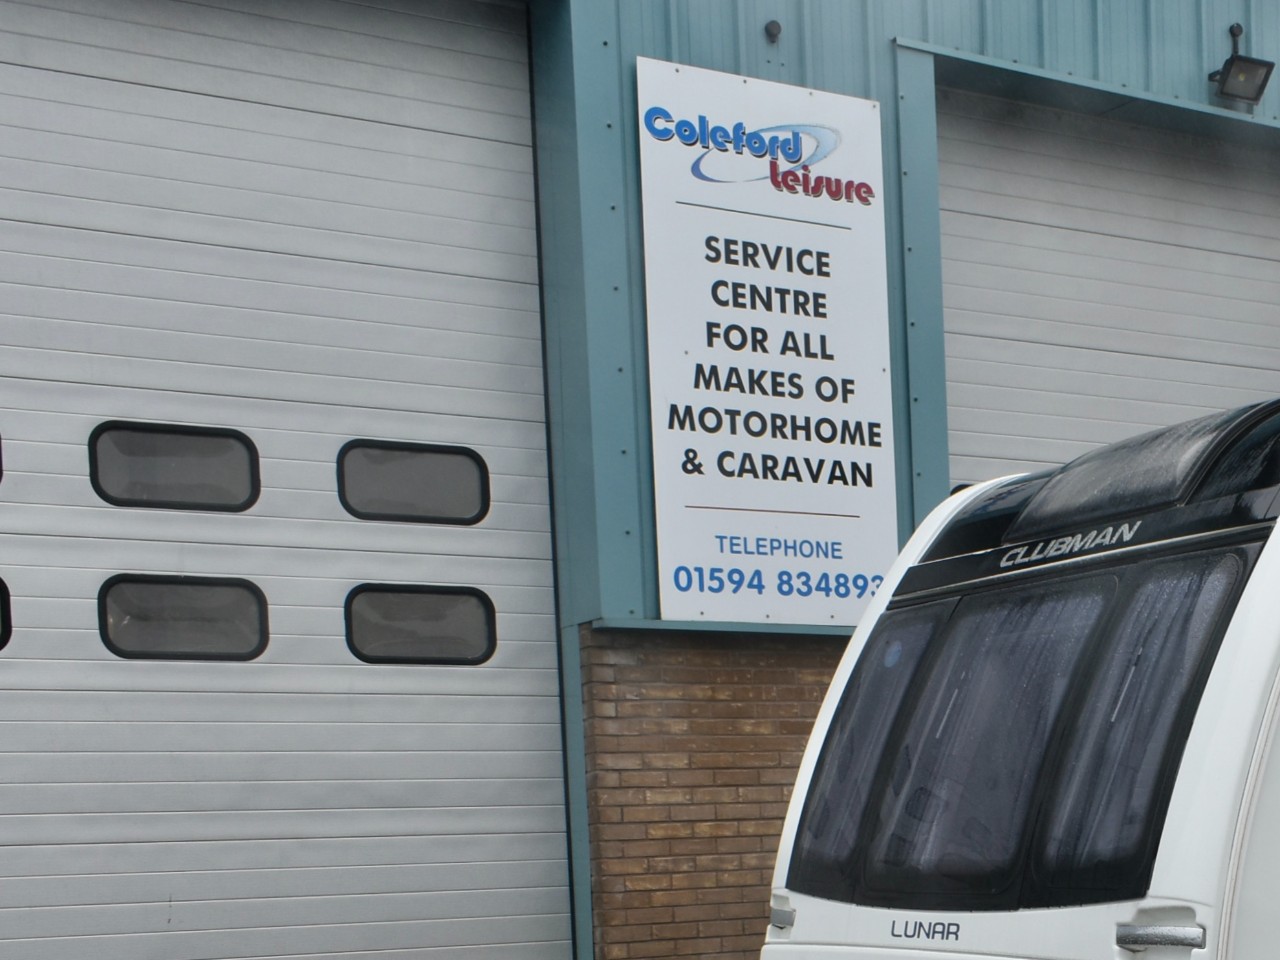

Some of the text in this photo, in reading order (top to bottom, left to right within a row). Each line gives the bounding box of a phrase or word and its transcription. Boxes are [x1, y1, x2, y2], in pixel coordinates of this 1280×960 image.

[644, 106, 802, 163] Coleford
[704, 235, 831, 278] SERVICE
[711, 279, 828, 319] CENTRE
[706, 321, 835, 361] FOR ALL
[694, 363, 855, 403] MAKES OF
[668, 403, 882, 447] MOTORHOME
[681, 448, 873, 488] & CARAVAN
[715, 535, 843, 559] TELEPHONE
[1000, 520, 1142, 568] CLUBMAN
[674, 566, 765, 595] 01594
[891, 920, 961, 941] LUNAR
